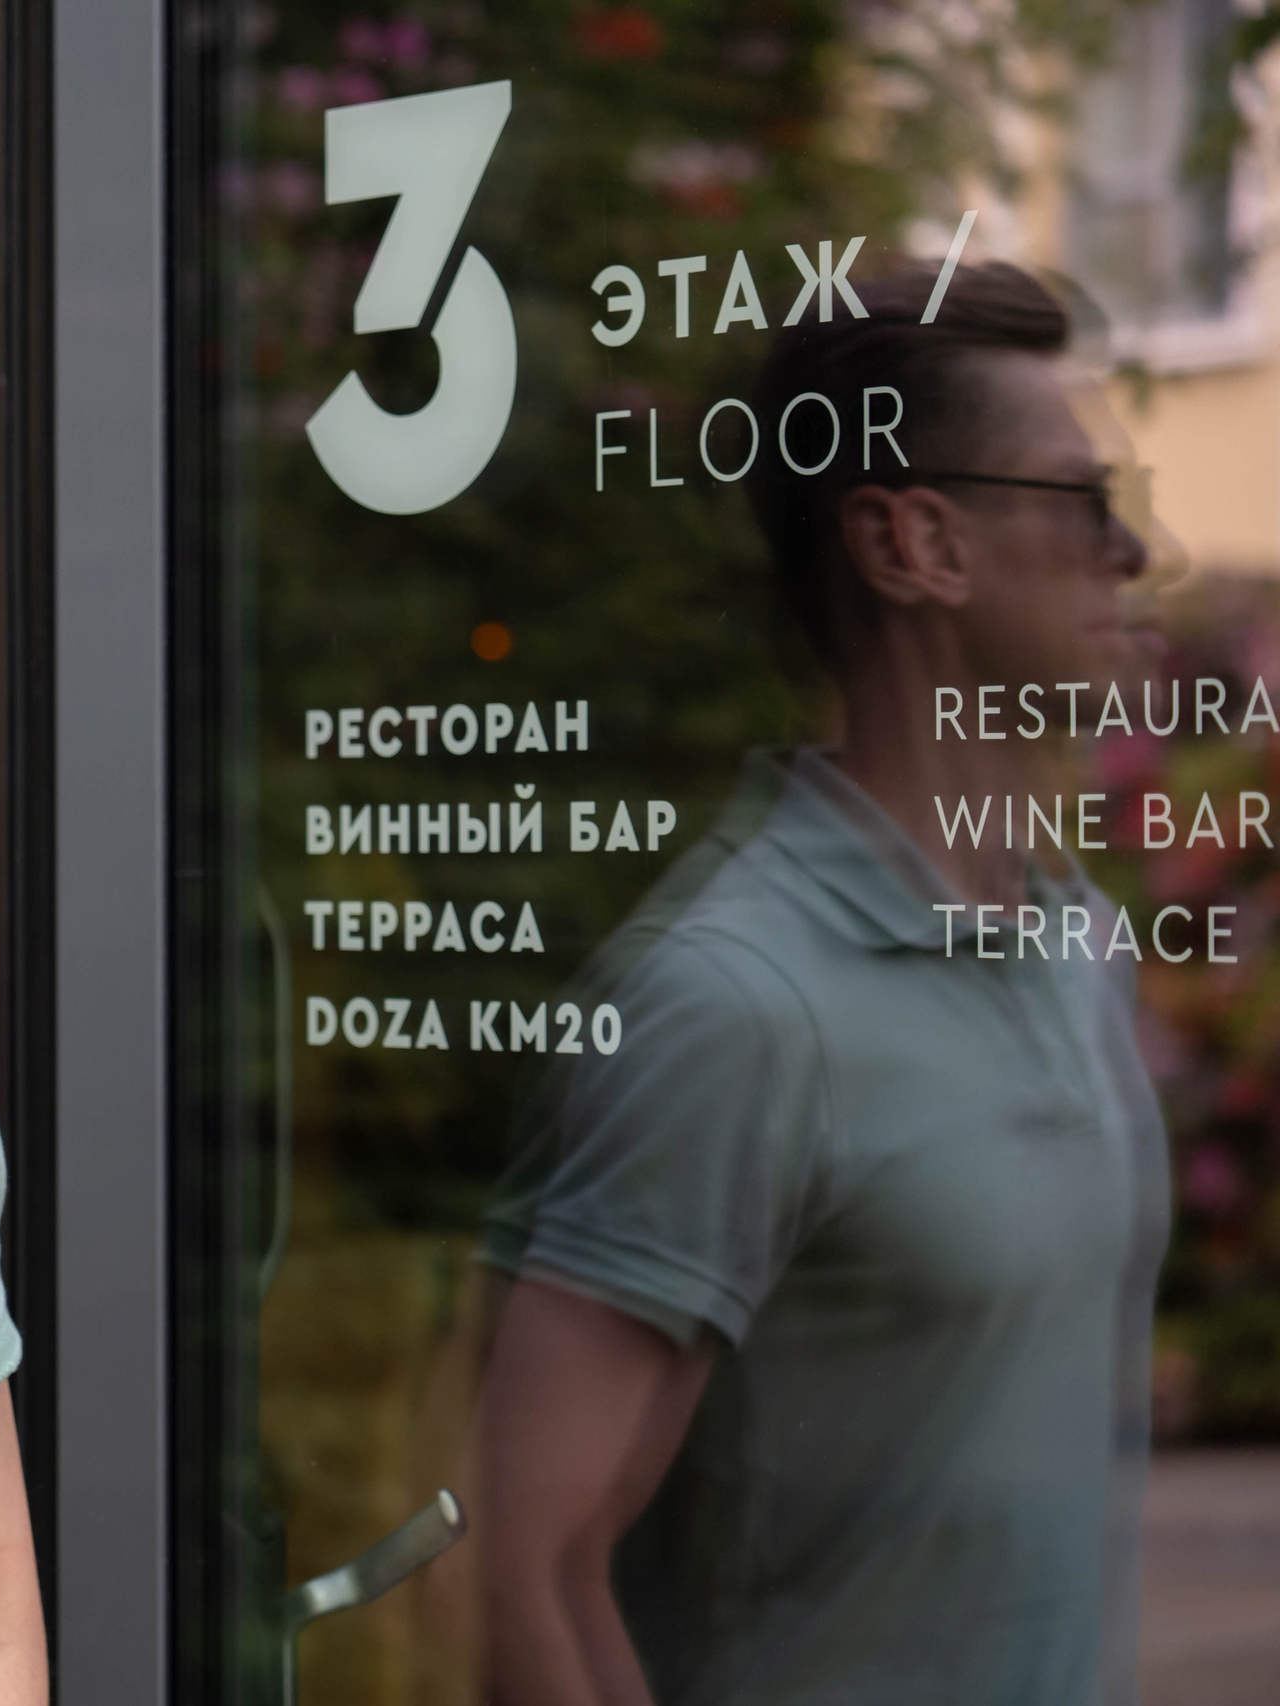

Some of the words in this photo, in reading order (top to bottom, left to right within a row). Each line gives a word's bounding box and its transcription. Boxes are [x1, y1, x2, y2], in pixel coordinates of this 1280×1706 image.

[305, 79, 517, 516] 3
[590, 235, 871, 348] ЭТАЖ
[594, 385, 910, 492] FLOOR
[305, 700, 590, 759] РЕСТОРАН
[934, 675, 1280, 741] RESTAURA
[305, 783, 544, 855] ВИННЫЙ
[569, 800, 678, 852] БАР
[933, 793, 1108, 850] WINE
[1142, 791, 1275, 849] BAR
[304, 900, 546, 953] ТЕРРАСА
[932, 904, 1239, 963] TERRACE
[305, 996, 450, 1051] DOZA
[469, 1001, 623, 1056] KM20
